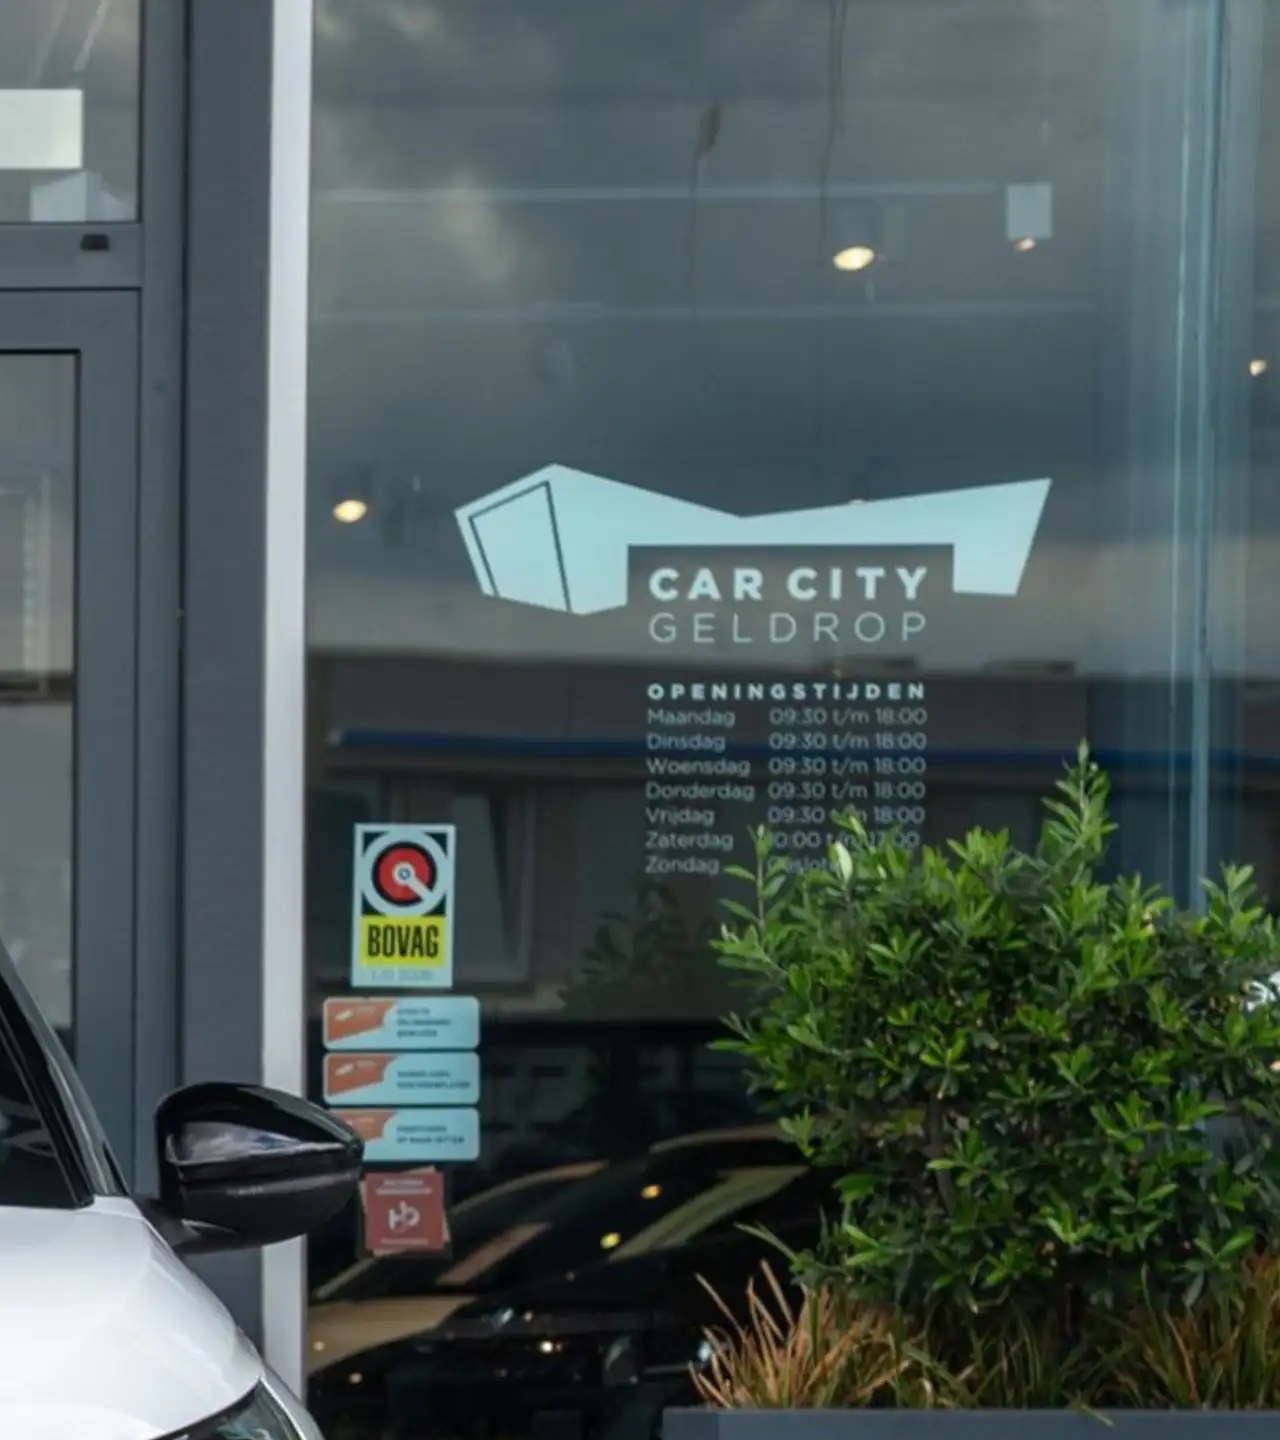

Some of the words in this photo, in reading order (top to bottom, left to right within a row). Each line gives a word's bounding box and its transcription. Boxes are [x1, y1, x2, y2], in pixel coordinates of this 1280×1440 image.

[648, 567, 764, 602] CAR
[786, 566, 928, 602] CITY
[648, 610, 928, 645] GELDROP
[647, 683, 924, 701] OPENINGSTIJDEN
[647, 707, 736, 728] Maandag
[769, 707, 827, 725] 09:30
[832, 706, 870, 726] t/m
[875, 707, 928, 725] 18:00
[646, 732, 726, 752] Dinsdag
[769, 732, 827, 750] 09:30
[832, 731, 870, 751] t/m
[875, 732, 928, 750] 18:00
[645, 757, 751, 777] Woensdag
[768, 757, 826, 775] 09:30
[831, 756, 869, 776] t/m
[874, 757, 926, 775] 18:00
[645, 781, 755, 802] Donderdag
[767, 782, 826, 800] 09:30
[831, 781, 868, 801] t/m
[873, 782, 926, 800] 18:00
[645, 807, 715, 827] Vrijdag
[767, 806, 825, 824] 09:30
[873, 806, 925, 824] 18:00
[645, 831, 734, 851] Zaterdag
[770, 831, 821, 848] 0:00
[645, 856, 720, 876] Zondag
[367, 924, 439, 959] BOVAG
